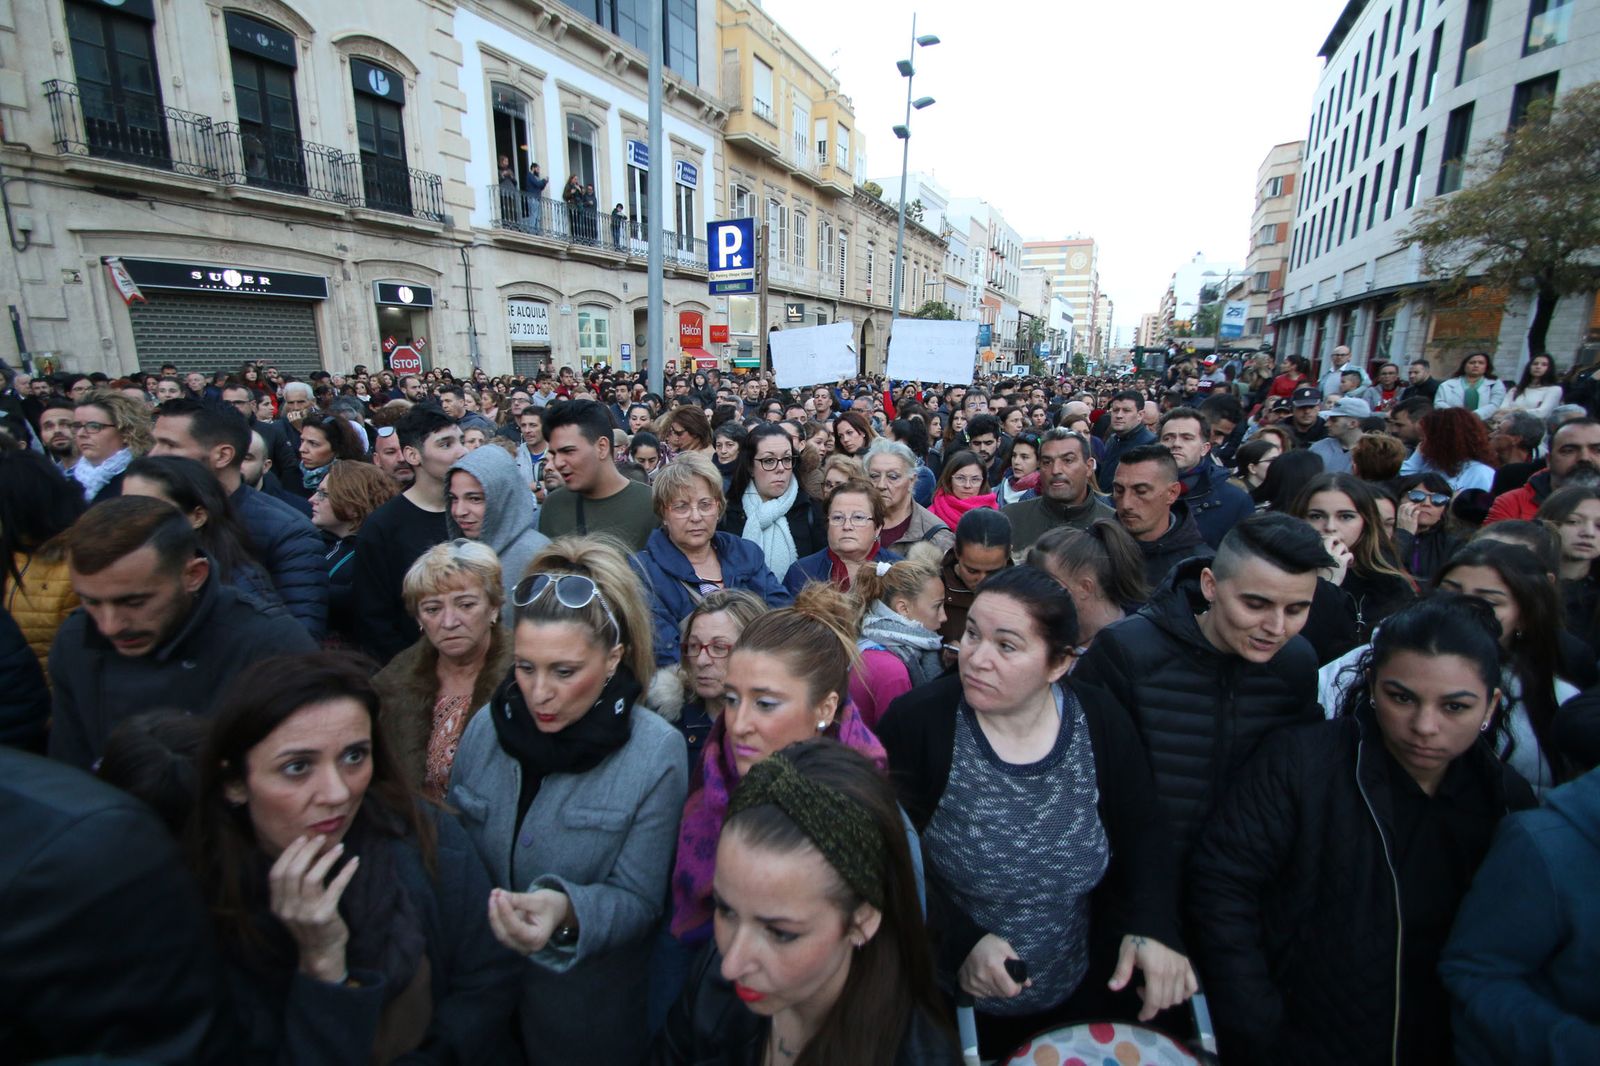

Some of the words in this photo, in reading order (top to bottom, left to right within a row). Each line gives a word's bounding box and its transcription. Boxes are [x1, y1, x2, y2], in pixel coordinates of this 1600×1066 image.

[718, 225, 743, 268] P
[191, 269, 271, 287] SUER
[517, 306, 547, 318] ALQUILA
[523, 323, 535, 335] 320
[536, 324, 549, 335] 262
[393, 359, 420, 369] STOP
